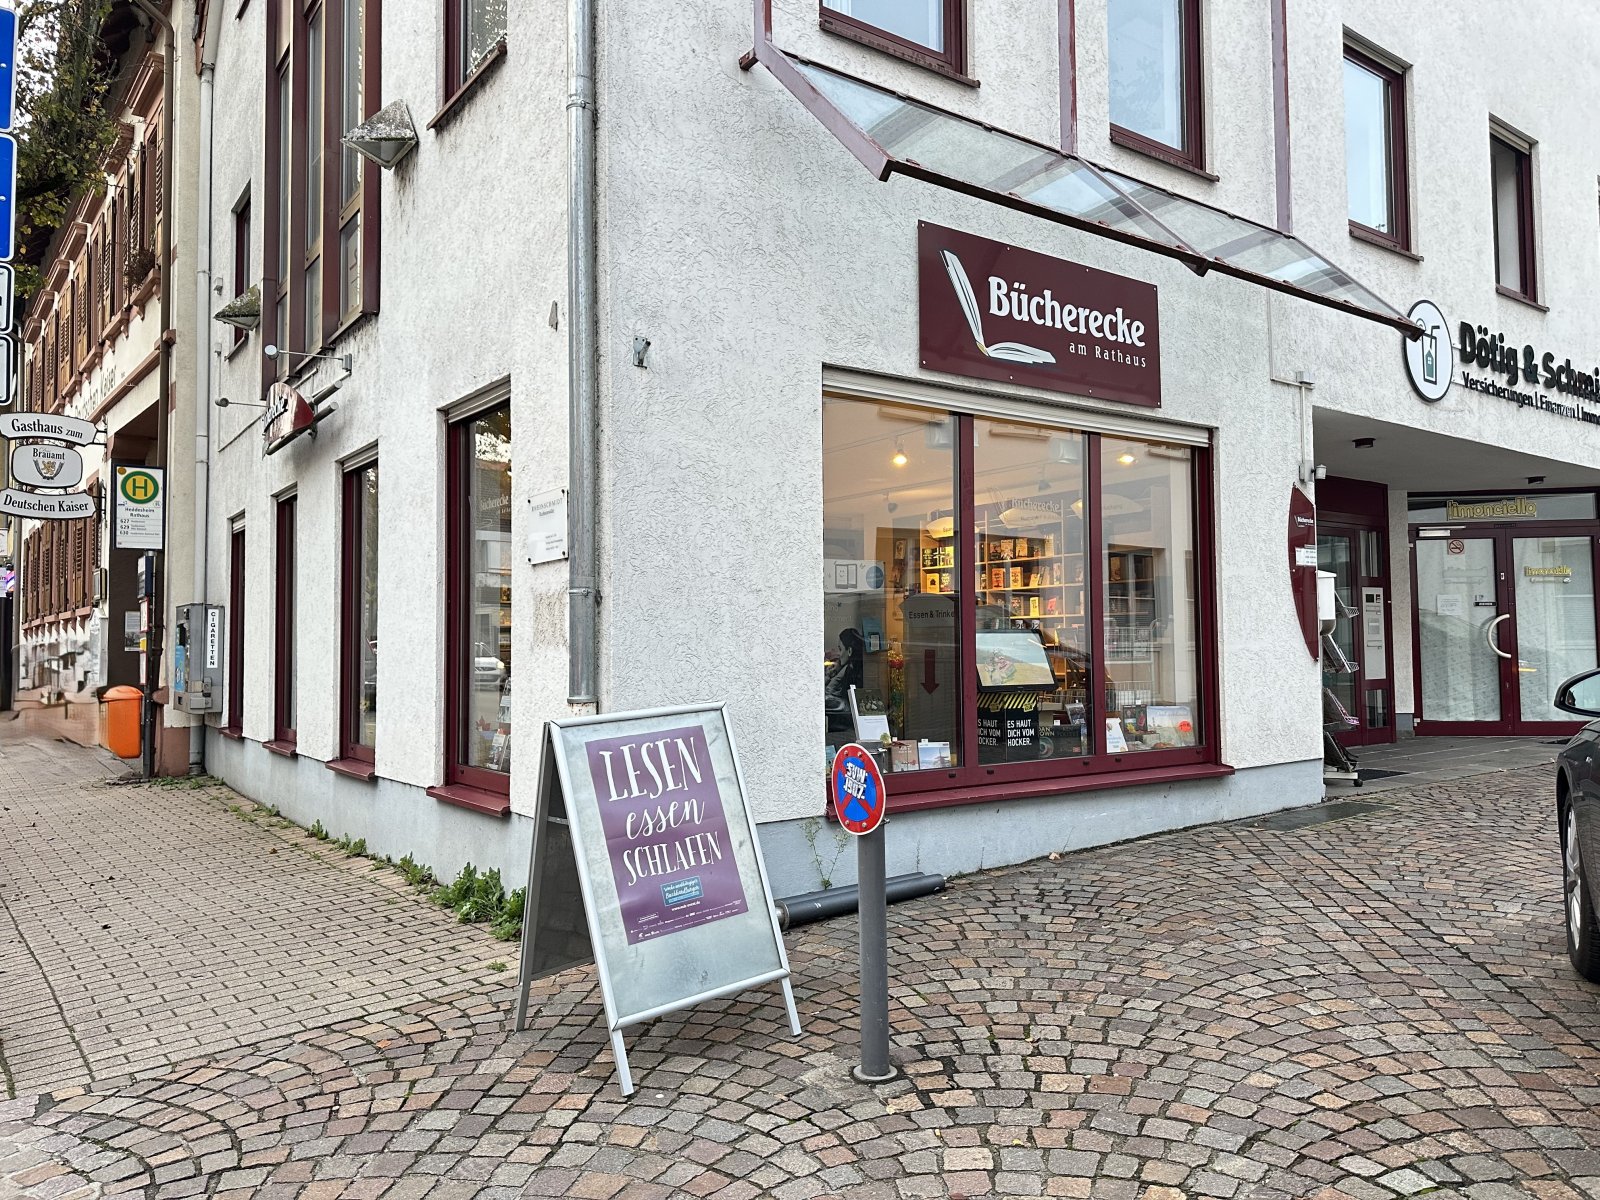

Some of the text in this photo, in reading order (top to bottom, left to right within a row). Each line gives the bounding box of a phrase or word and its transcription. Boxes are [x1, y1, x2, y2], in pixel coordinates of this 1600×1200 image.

[987, 276, 1146, 347] Bücherecke
[1069, 342, 1147, 368] am Rathaus
[1459, 321, 1600, 403] Dötig & Schmi
[1462, 371, 1533, 408] Versicherungen
[1540, 394, 1576, 418] Finanzen
[11, 418, 83, 439] Gasthaus zum
[132, 478, 148, 497] H
[3, 494, 89, 512] Deutschen Kaiser
[1447, 496, 1537, 518] limonciello
[908, 611, 929, 619] Essen
[929, 610, 934, 618] &
[982, 719, 998, 728] HAUT
[989, 728, 1001, 737] VOM
[1007, 719, 1032, 729] ES HAUT
[1007, 728, 1035, 738] DICH VOM
[978, 736, 999, 746] OCKER.
[1007, 737, 1033, 747] HOCKER.
[599, 736, 703, 802] LESEN
[626, 798, 705, 840] essen
[622, 831, 723, 887] SCHLAFEN
